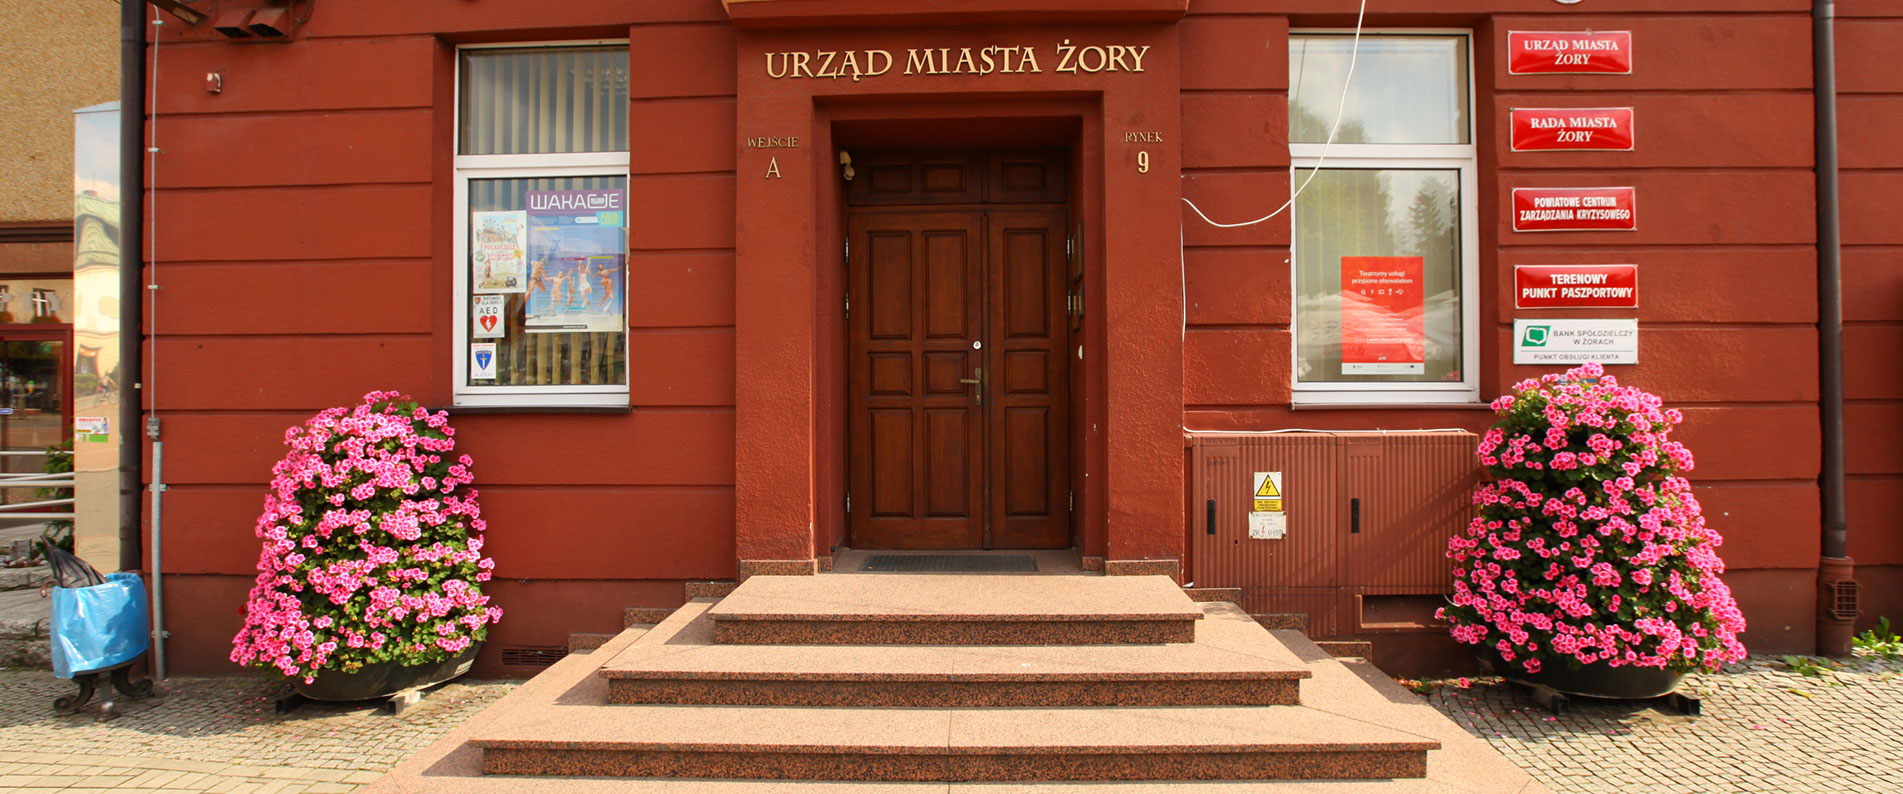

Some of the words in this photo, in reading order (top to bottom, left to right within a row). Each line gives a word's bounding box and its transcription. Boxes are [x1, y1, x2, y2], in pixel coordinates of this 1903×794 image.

[1523, 39, 1569, 52] URZĄD
[1572, 39, 1619, 51] MIASTA
[765, 49, 893, 82] URZĄD
[903, 44, 1043, 76] MIASTA
[1055, 38, 1151, 75] ŻORY
[1554, 51, 1592, 65] ŻORY
[1530, 117, 1566, 128] RADA
[1569, 117, 1618, 128] MIASTA
[1124, 131, 1164, 143] RYNEK
[1556, 128, 1594, 142] ŻORY
[747, 135, 800, 149] WEJŚCIE
[765, 156, 782, 179] A
[1136, 151, 1149, 174] 9
[1534, 197, 1580, 208] POWIATOWE
[1582, 196, 1617, 207] CENTRUM
[1520, 210, 1574, 222] ZARZĄDZANIA
[1576, 209, 1631, 221] KRYZYSOWEGO
[1359, 270, 1387, 278] Tworzymy
[1550, 273, 1608, 285] TERENOWY
[1522, 287, 1557, 299] PUNKT
[1561, 287, 1633, 298] PASZPORTOWY
[1577, 328, 1633, 337] SPÓŁDZIELCZY
[1582, 336, 1614, 345] ŻORACH
